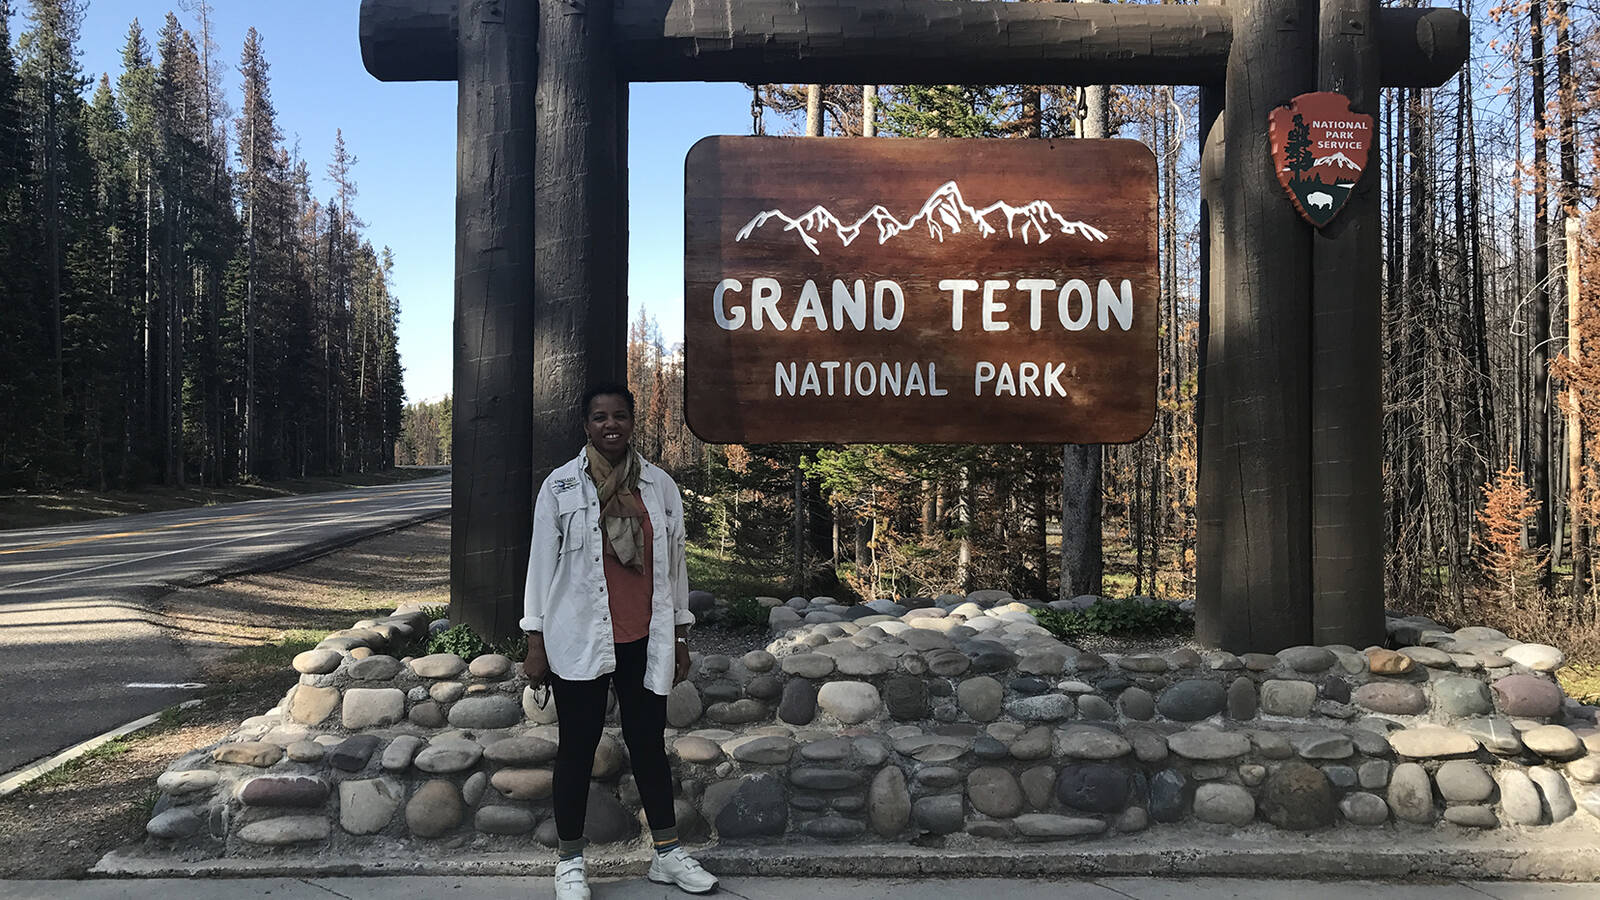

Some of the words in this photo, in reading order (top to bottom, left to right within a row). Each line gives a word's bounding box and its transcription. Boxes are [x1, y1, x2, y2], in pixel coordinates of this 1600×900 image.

[1312, 121, 1368, 130] NATIONAL
[1325, 131, 1354, 139] PARK
[1317, 140, 1362, 150] SERVICE
[713, 278, 904, 332] GRAND
[938, 279, 1134, 332] TETON
[774, 361, 948, 397] NATIONAL
[974, 361, 1067, 398] PARK
